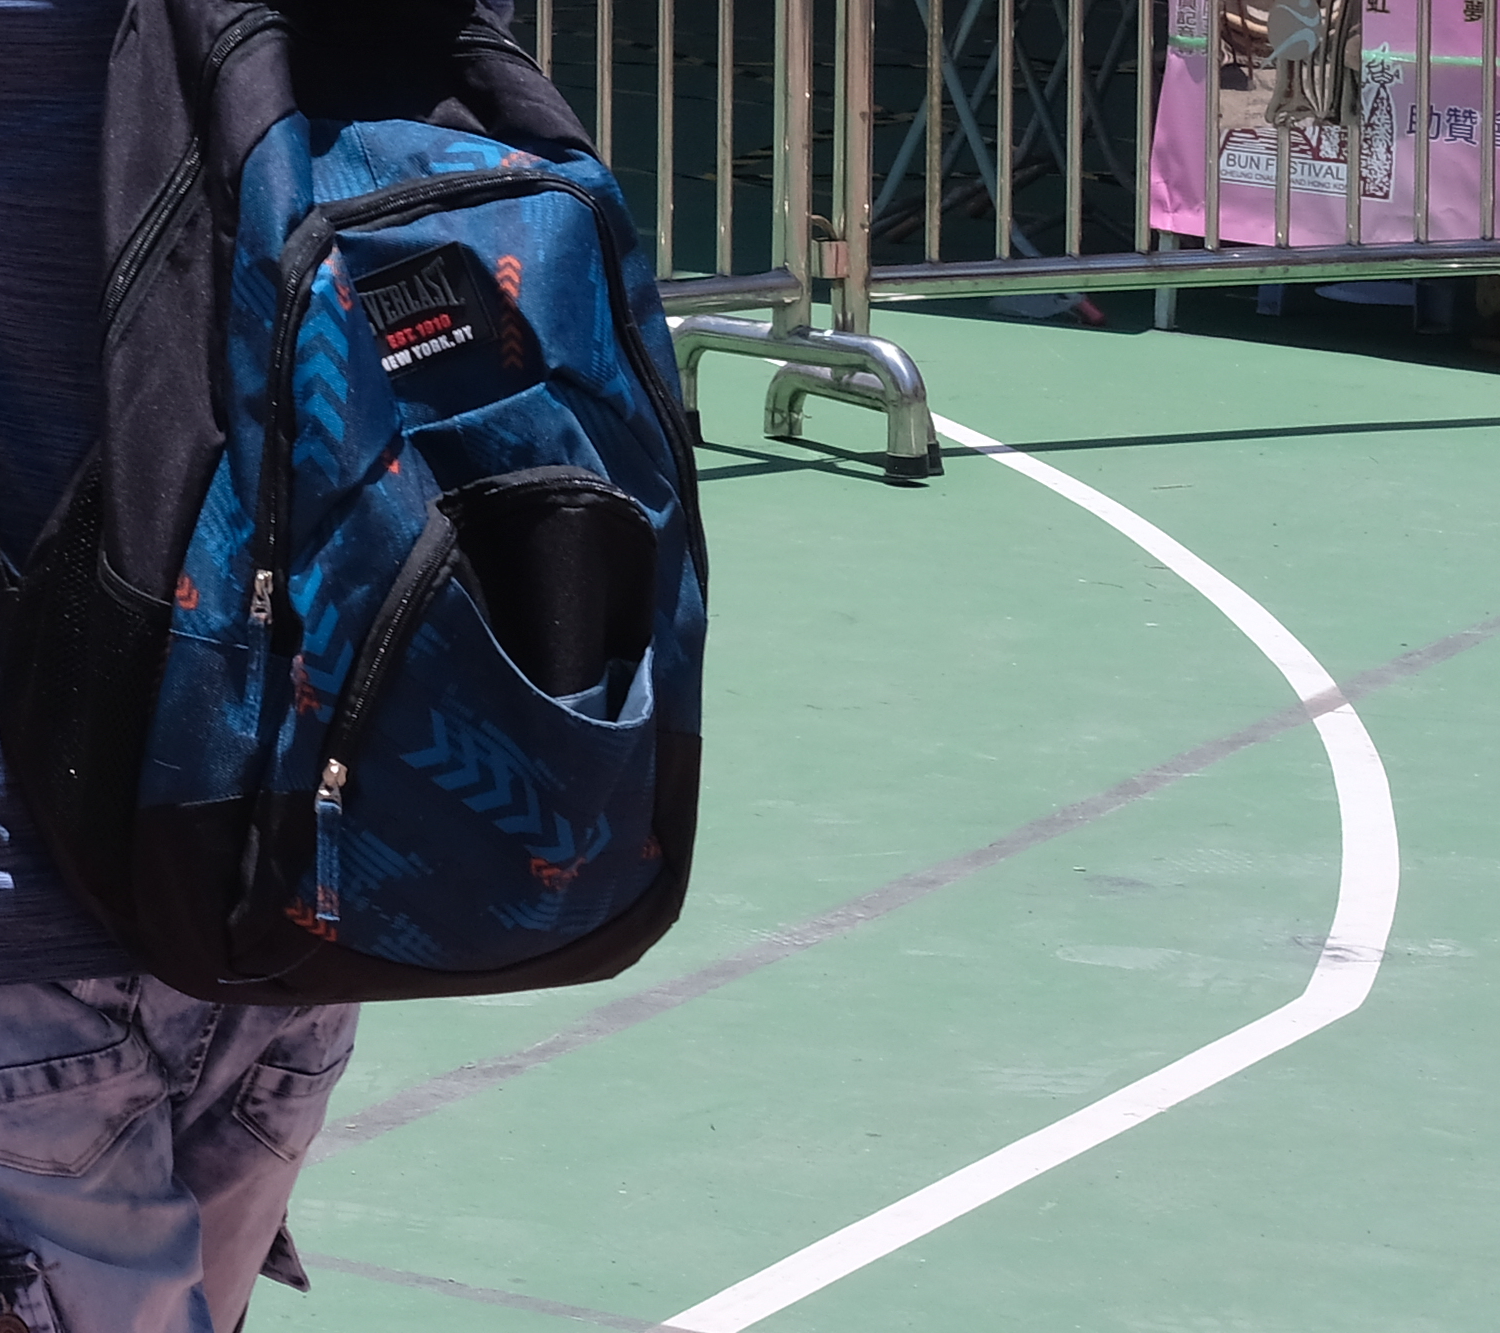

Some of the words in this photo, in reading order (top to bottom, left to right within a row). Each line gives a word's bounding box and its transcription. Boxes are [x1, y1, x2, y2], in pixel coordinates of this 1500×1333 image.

[1226, 153, 1263, 170] BUN
[1266, 156, 1346, 181] FSTIVAL
[357, 255, 460, 331] VERLAST
[451, 325, 475, 344] NY
